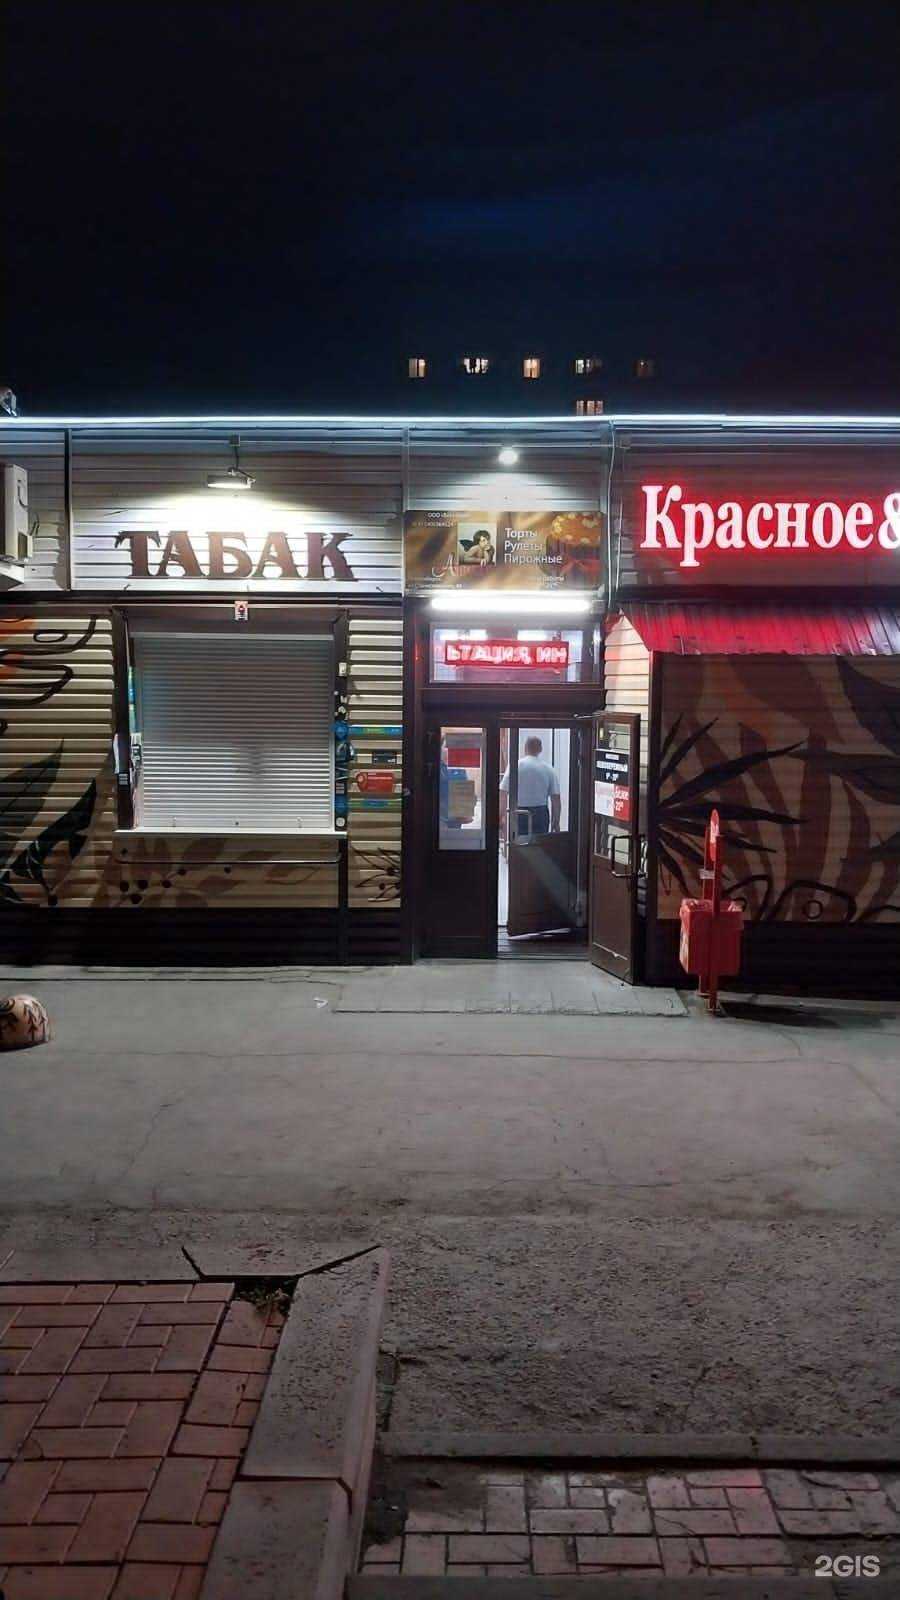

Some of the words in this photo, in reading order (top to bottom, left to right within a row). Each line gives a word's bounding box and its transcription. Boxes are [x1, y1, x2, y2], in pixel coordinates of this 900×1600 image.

[504, 527, 538, 540] Торты
[504, 540, 543, 552] Рулеты
[115, 530, 358, 582] ТАБАК
[504, 553, 563, 565] Пирожные
